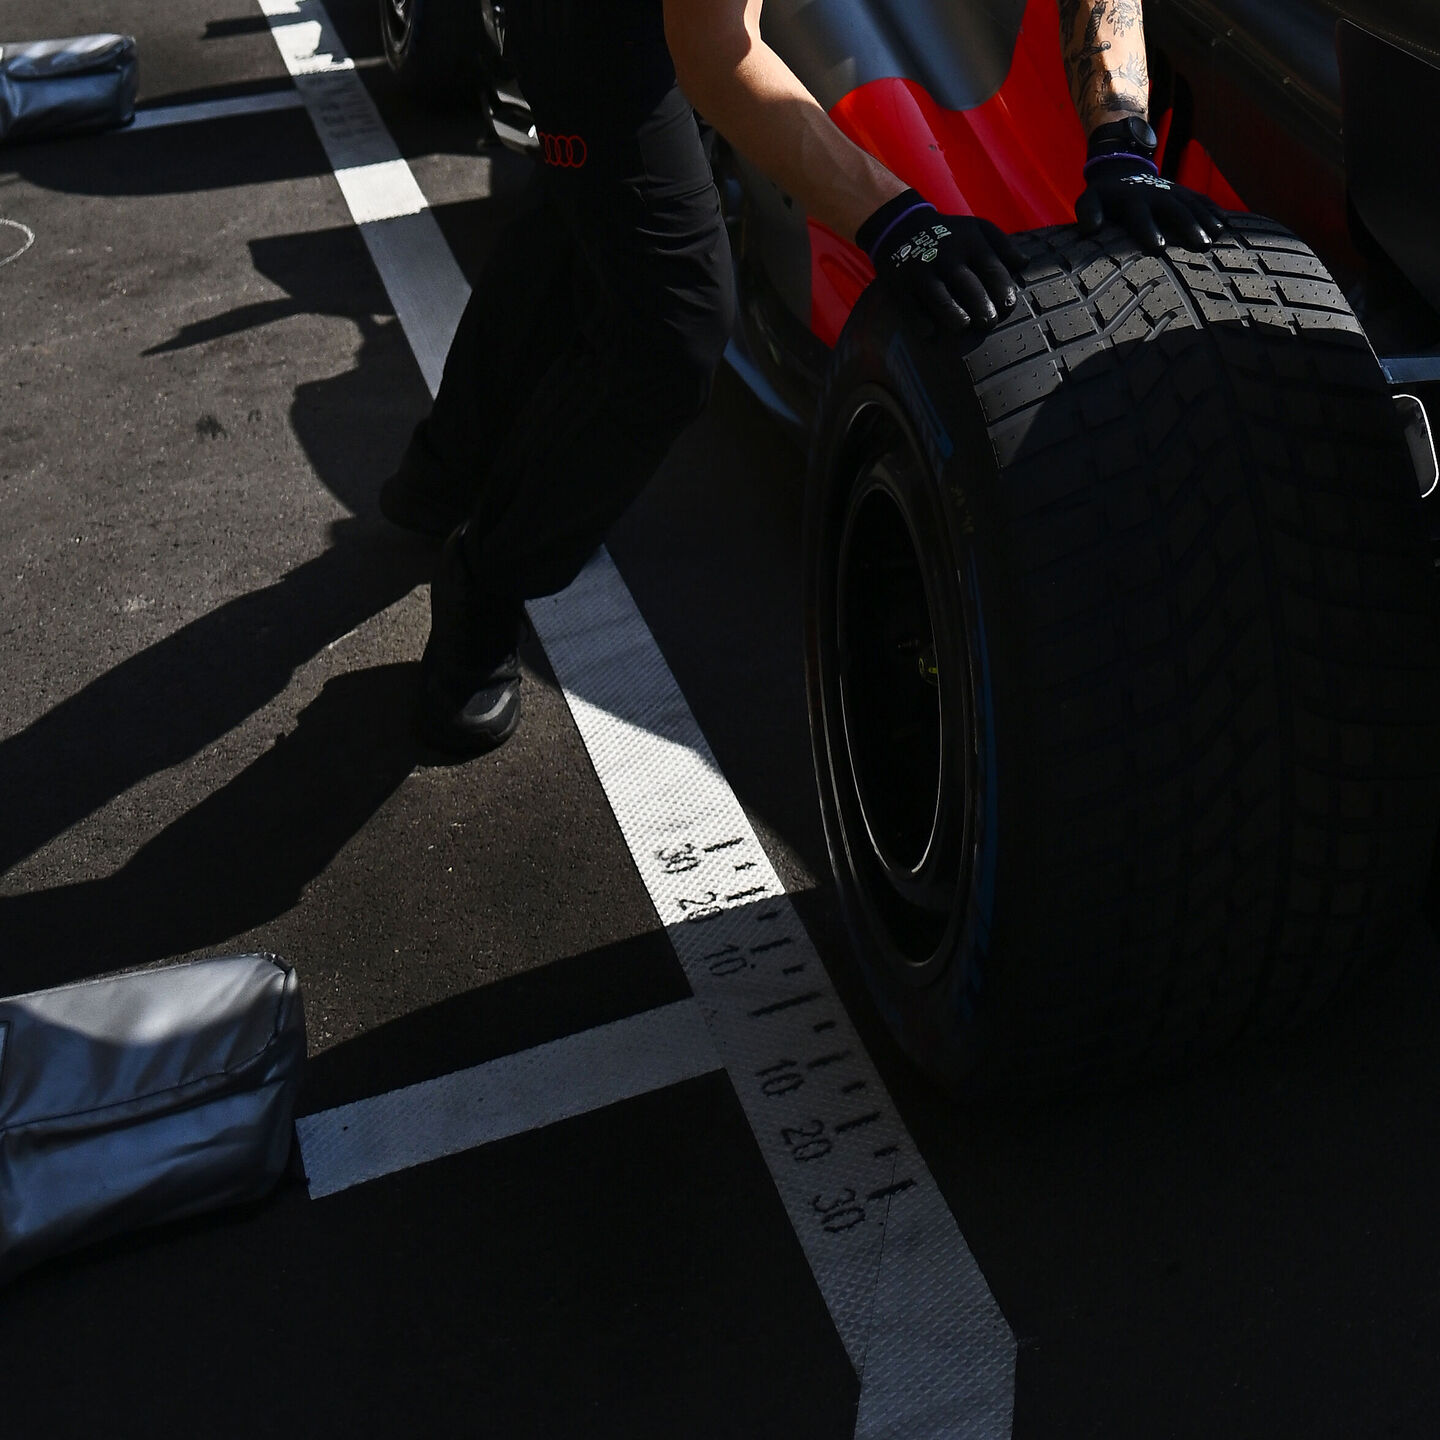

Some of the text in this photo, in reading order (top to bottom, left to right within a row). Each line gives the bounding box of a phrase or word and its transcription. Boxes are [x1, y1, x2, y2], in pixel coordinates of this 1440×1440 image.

[703, 943, 748, 976] 10
[755, 1058, 804, 1097] 10
[780, 1119, 832, 1162] 20
[807, 1187, 866, 1233] 30
